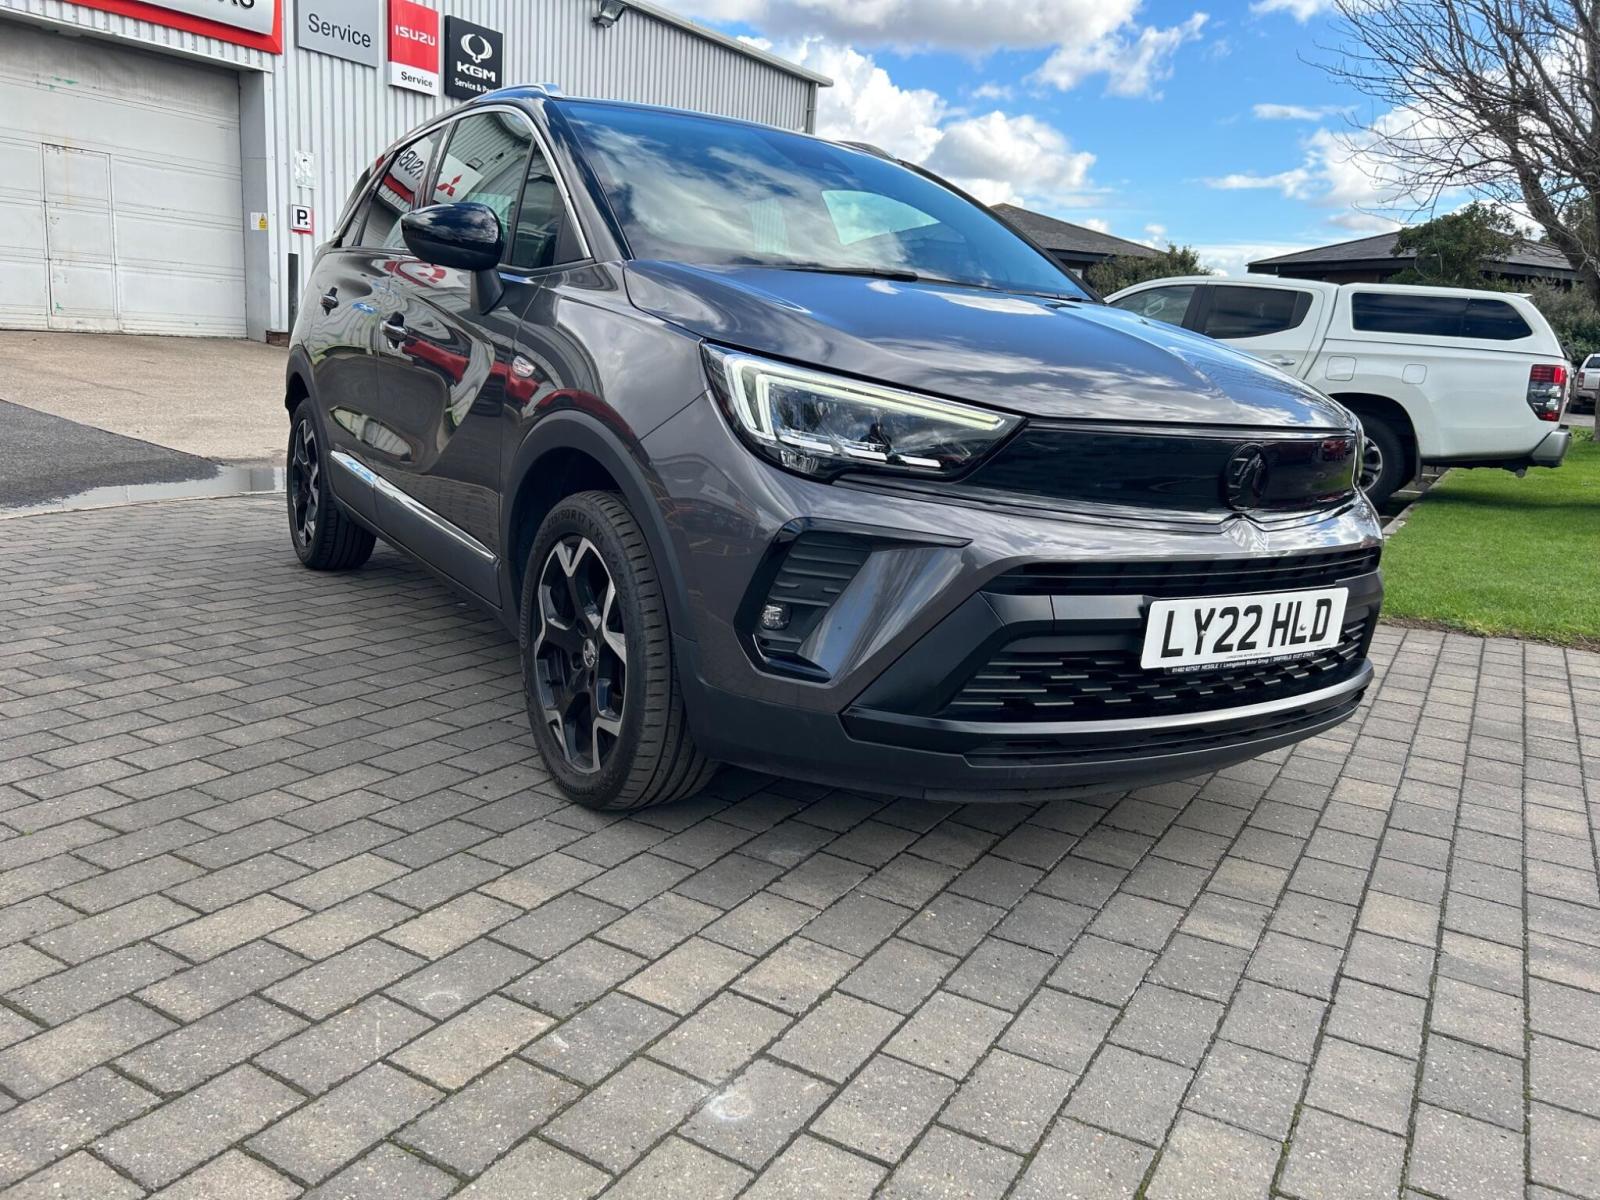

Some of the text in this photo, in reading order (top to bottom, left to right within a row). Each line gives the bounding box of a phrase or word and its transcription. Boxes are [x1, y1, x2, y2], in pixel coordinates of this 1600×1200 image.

[308, 13, 371, 48] Service
[394, 24, 436, 46] ISUZU
[401, 71, 433, 88] Service
[456, 61, 496, 82] KGM
[454, 77, 476, 91] Service
[296, 209, 307, 225] P
[1160, 598, 1332, 659] LY22 HLD
